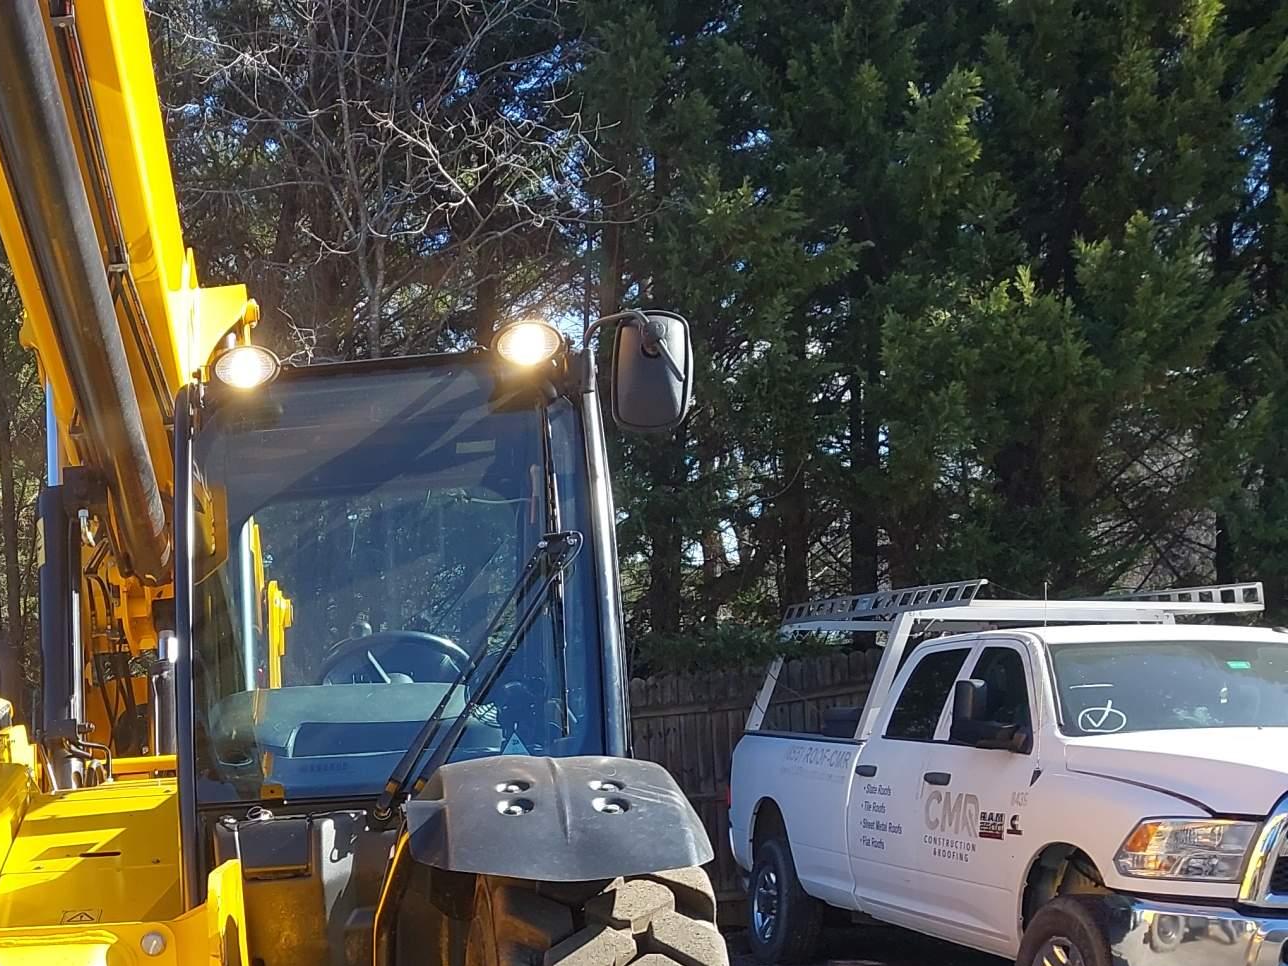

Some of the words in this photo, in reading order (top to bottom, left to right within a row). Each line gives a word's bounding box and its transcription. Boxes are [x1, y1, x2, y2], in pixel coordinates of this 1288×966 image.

[878, 784, 892, 796] Roofs
[864, 800, 872, 812] Tile
[872, 801, 886, 814] Roofs
[924, 789, 980, 839] CMR
[979, 811, 1005, 823] RAM
[862, 818, 875, 830] Sheet
[875, 820, 888, 832] Metal
[888, 822, 903, 835] Roofs
[871, 837, 885, 850] Roofs
[923, 834, 977, 853] CONSTRUCTION
